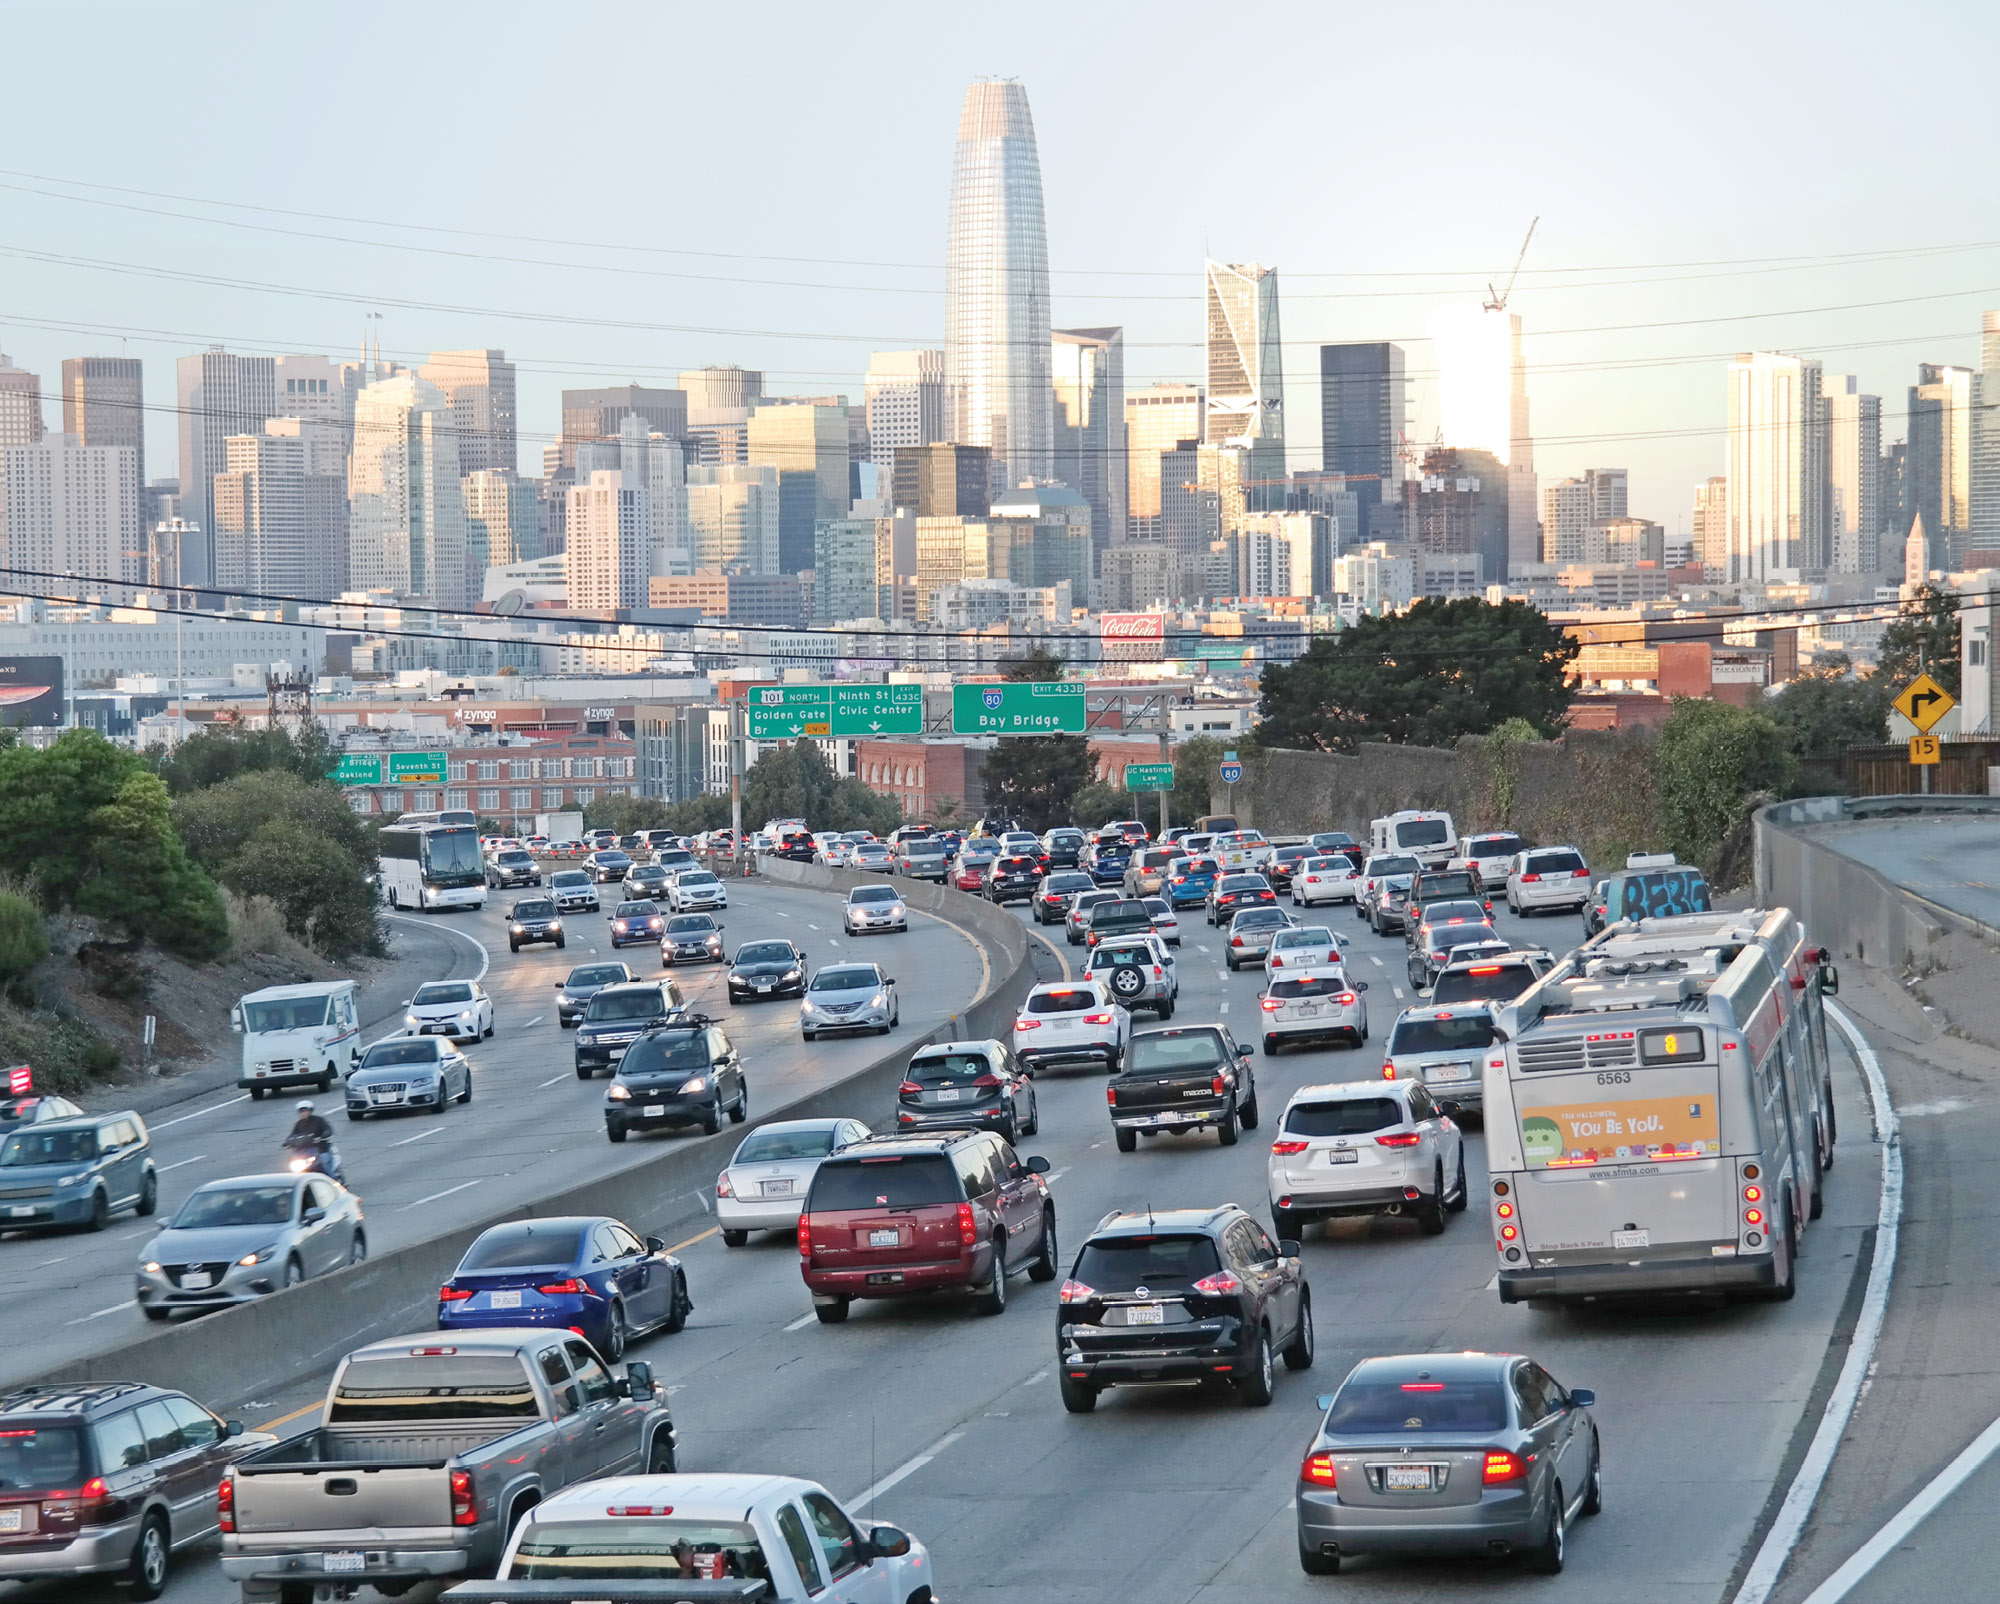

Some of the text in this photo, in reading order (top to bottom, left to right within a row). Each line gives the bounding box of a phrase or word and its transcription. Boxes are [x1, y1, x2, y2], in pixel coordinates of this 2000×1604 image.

[1103, 618, 1160, 637] Coca-Cola
[1034, 684, 1084, 693] EXIT 433B
[765, 693, 780, 703] 101
[789, 693, 821, 702] NORTH
[838, 690, 889, 701] Ninth St
[895, 693, 920, 701] 433C
[985, 695, 1000, 705] 80
[464, 709, 497, 722] zynga
[590, 708, 615, 720] zynga
[754, 709, 826, 720] Golden Gate
[839, 705, 913, 715] Civic Center
[979, 714, 1060, 728] Bay Bridge
[754, 726, 768, 735] Br
[1915, 739, 1935, 755] 15
[1139, 766, 1172, 775] Hastings
[1224, 770, 1238, 779] 80
[1664, 1033, 1678, 1056] 8
[1596, 1072, 1632, 1086] 6563
[1588, 1166, 1660, 1180] www.sfmta.com
[1616, 1235, 1647, 1247] 1470932
[1540, 1243, 1558, 1251] Stop
